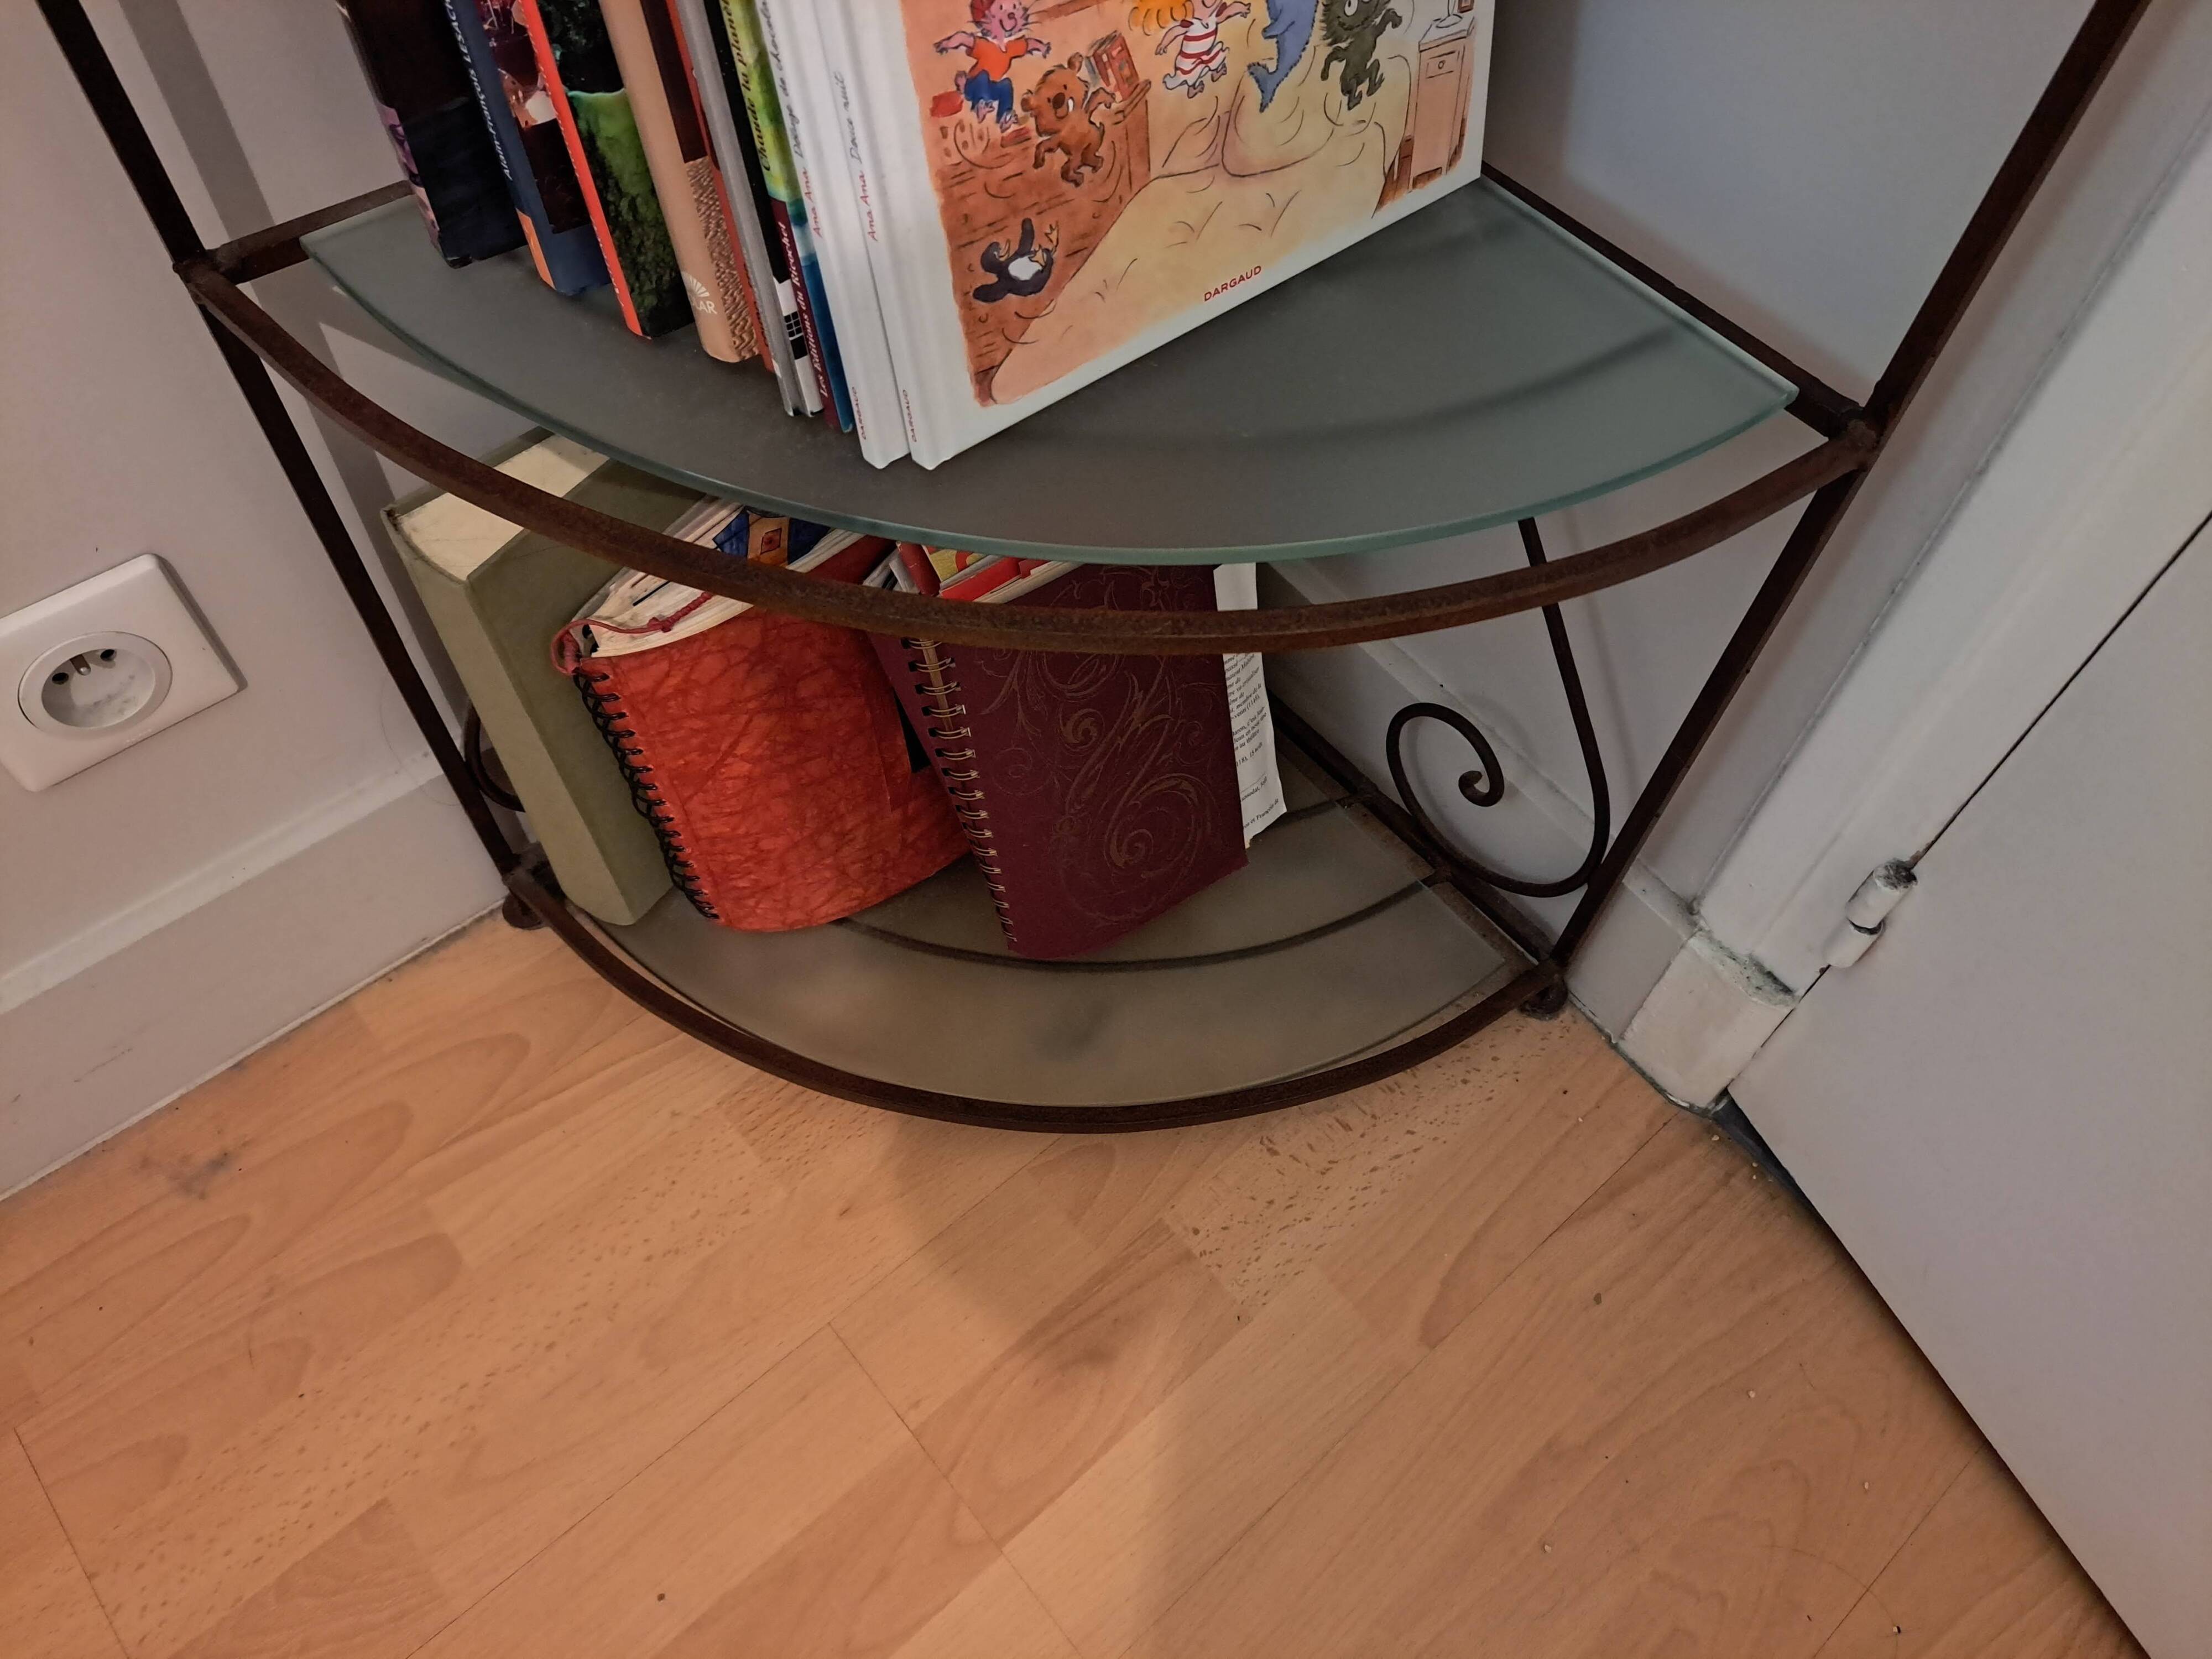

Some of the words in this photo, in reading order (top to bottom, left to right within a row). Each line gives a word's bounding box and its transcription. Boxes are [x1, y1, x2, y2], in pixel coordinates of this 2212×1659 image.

[742, 72, 752, 92] la
[468, 68, 513, 181] Alain-François
[747, 97, 770, 172] Chaude
[847, 118, 863, 164] Douce
[802, 167, 814, 204] Ana
[859, 171, 870, 207] Ana
[811, 206, 823, 238] Ana
[867, 210, 879, 242] Ana
[778, 221, 801, 288] Ricochet
[797, 291, 806, 310] du
[1204, 265, 1262, 302] DARGAUD
[818, 374, 828, 398] Les
